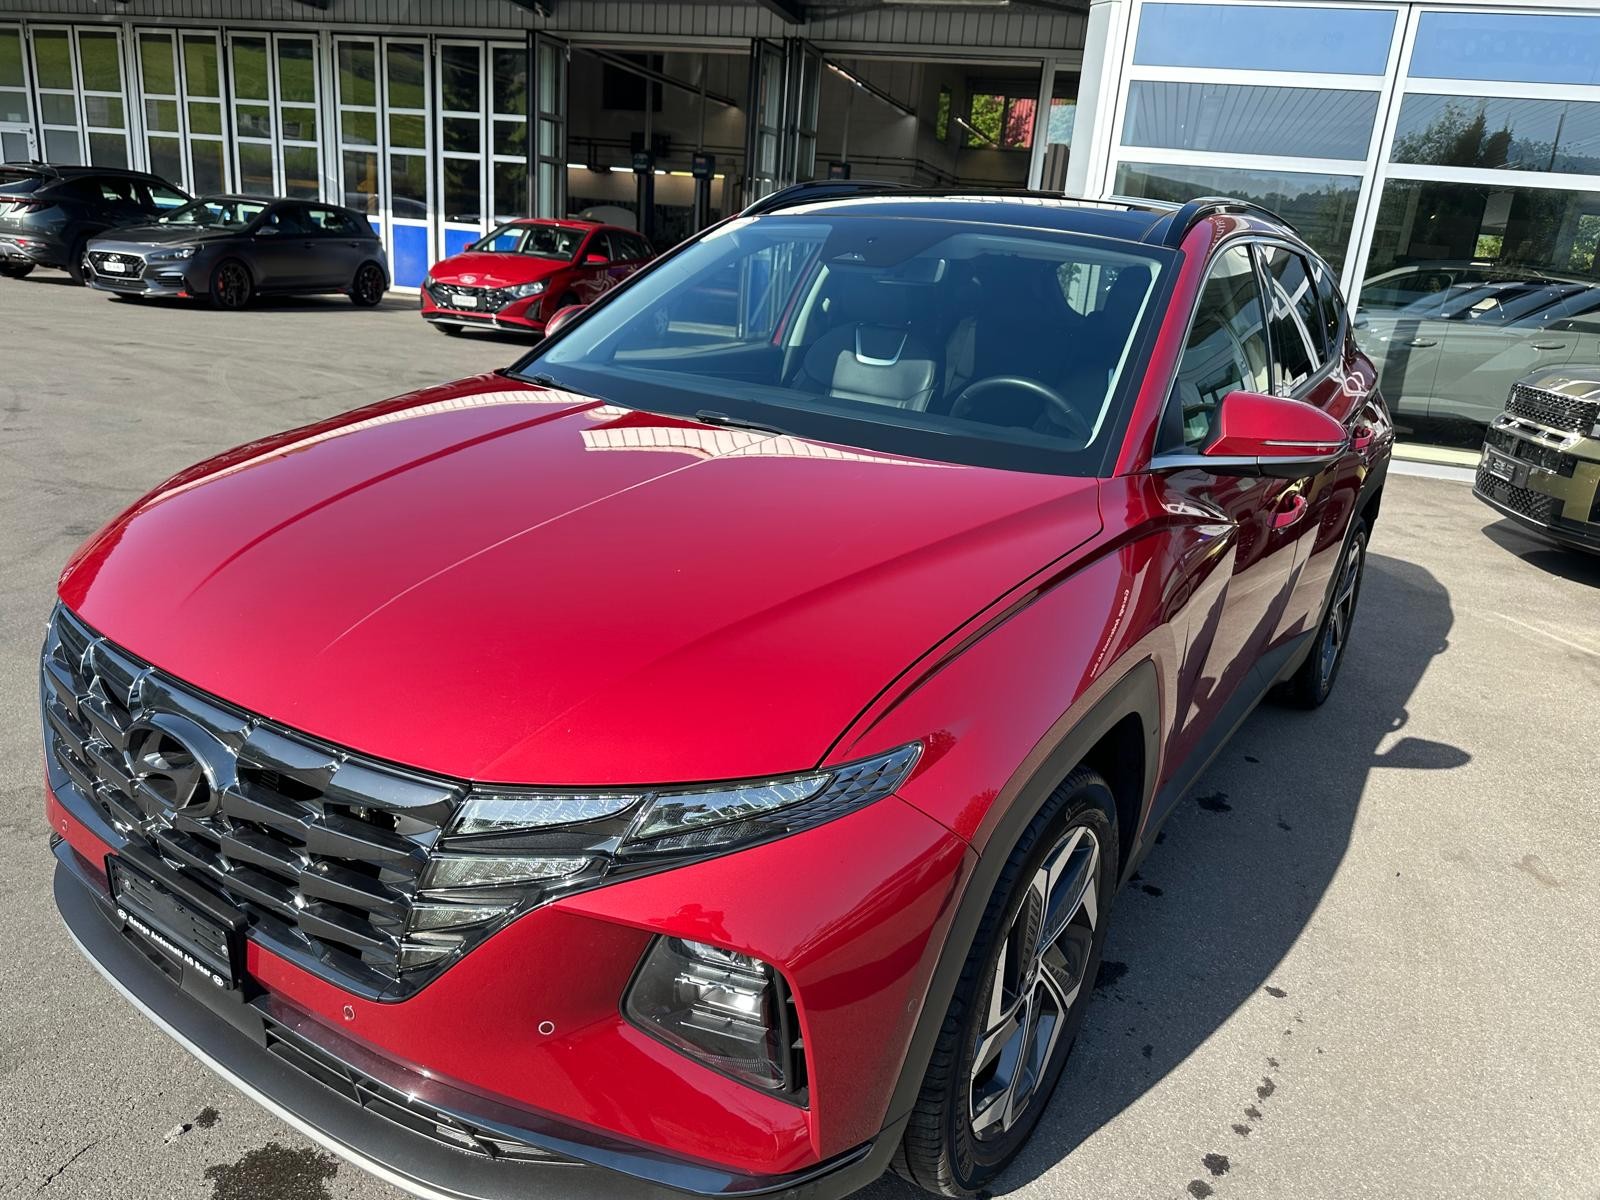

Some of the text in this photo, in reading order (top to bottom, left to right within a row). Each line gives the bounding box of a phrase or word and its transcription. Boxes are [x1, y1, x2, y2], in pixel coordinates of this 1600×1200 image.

[128, 915, 150, 935] Garage
[184, 953, 194, 966] AG
[195, 960, 211, 977] Baar
